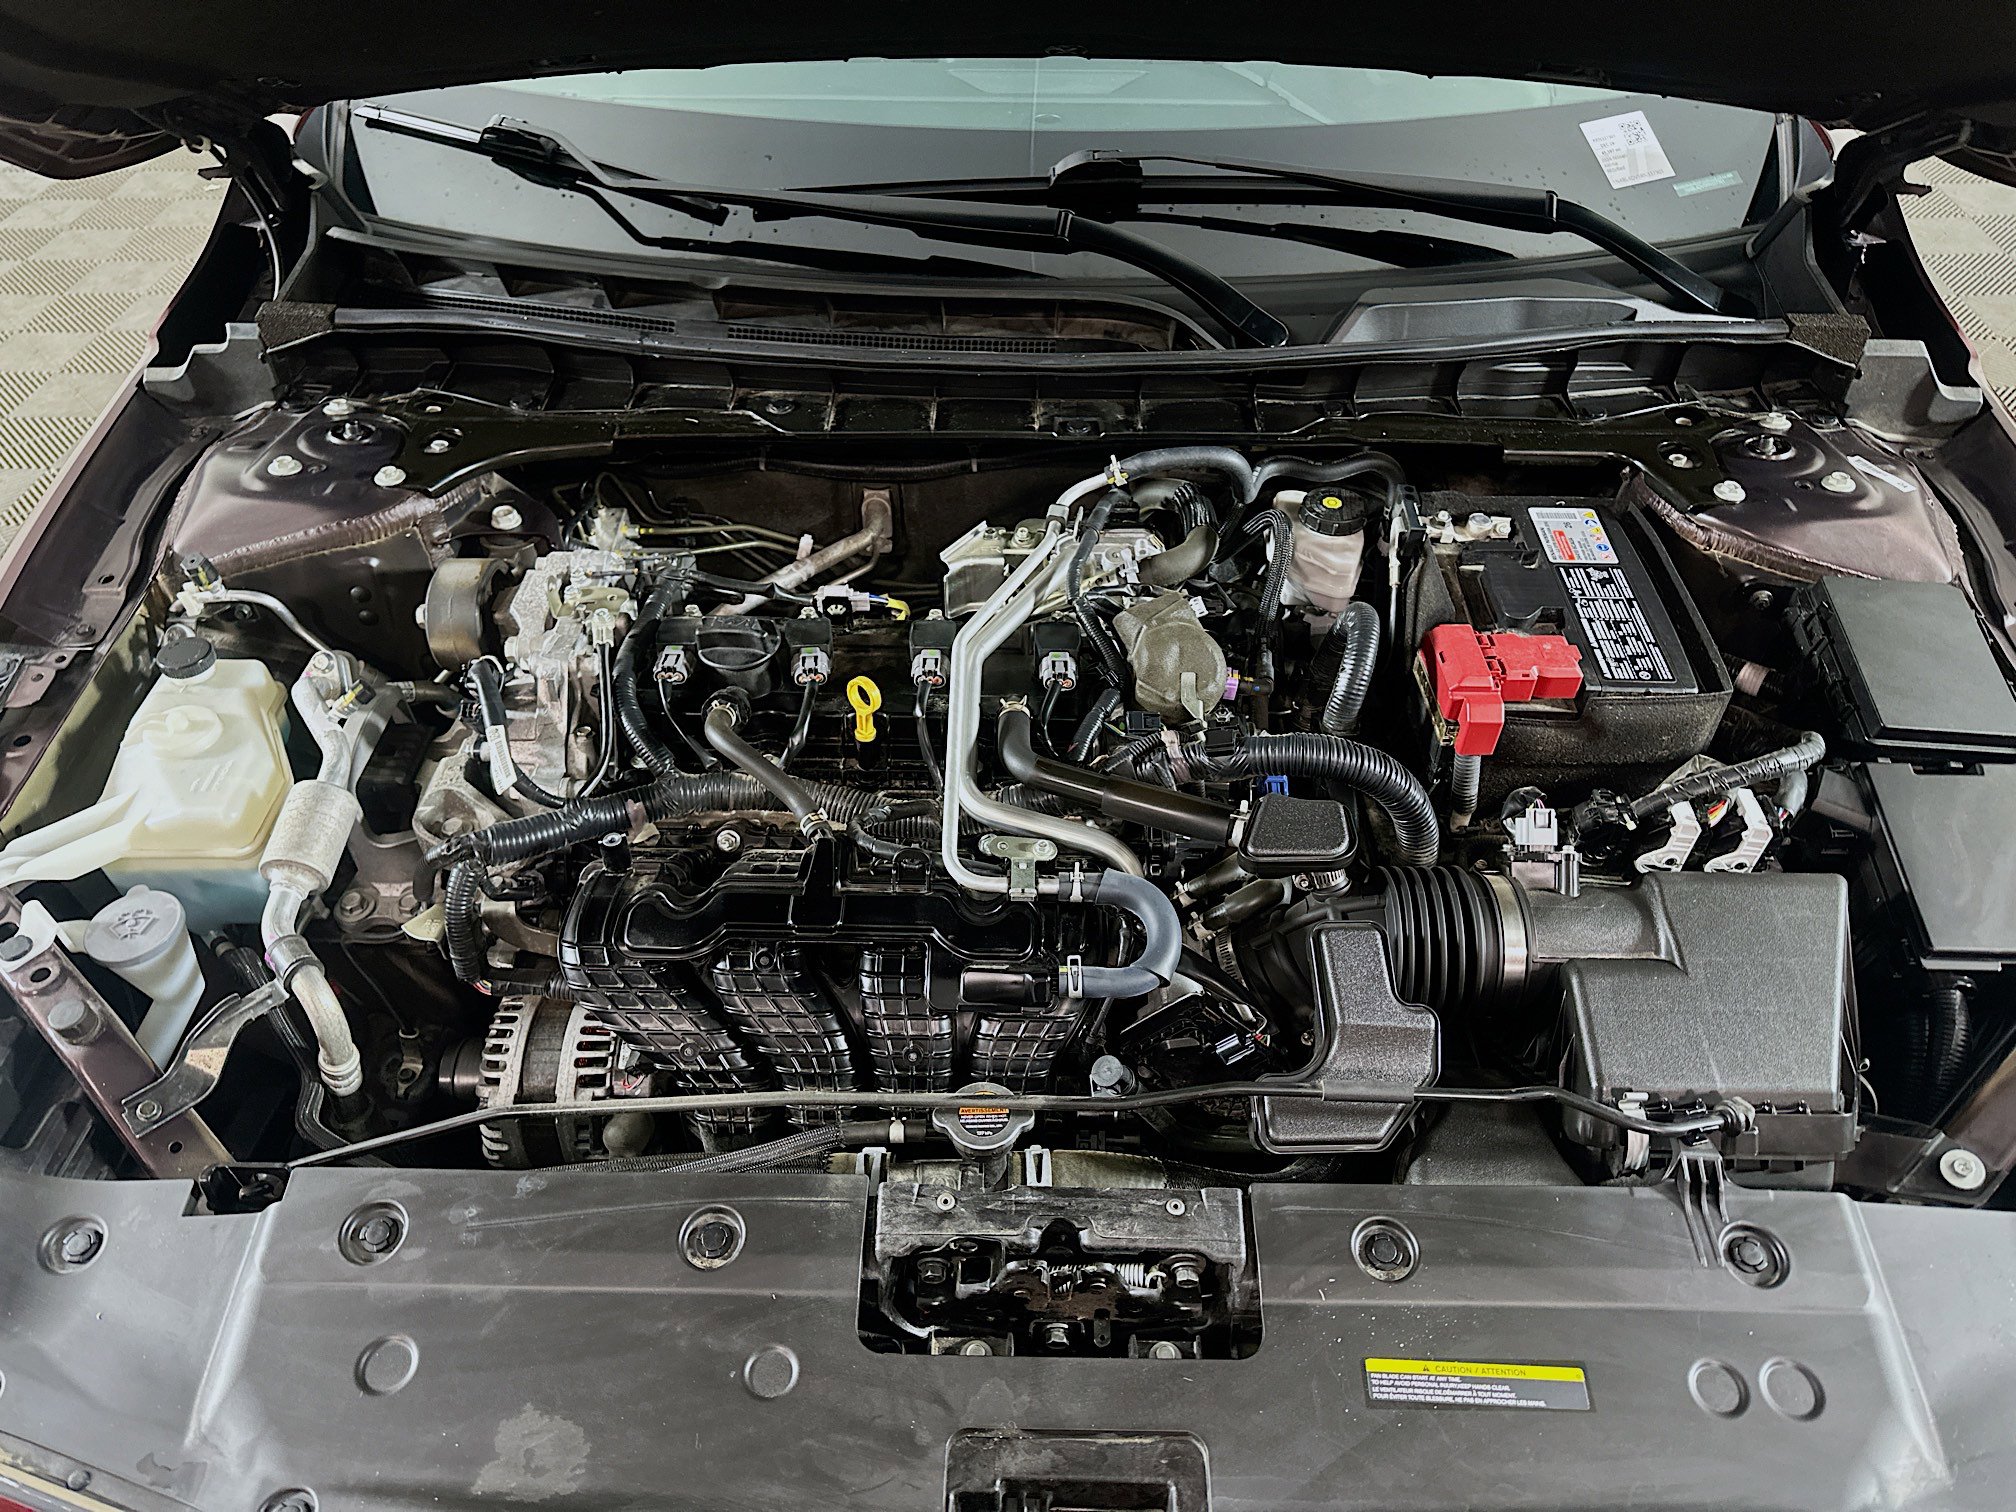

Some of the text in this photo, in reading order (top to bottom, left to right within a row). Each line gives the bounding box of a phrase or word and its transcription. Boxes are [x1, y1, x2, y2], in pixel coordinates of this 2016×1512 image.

[1435, 1365, 1472, 1374] CAUTION
[1481, 1368, 1527, 1376] ATTENTION
[1389, 1392, 1407, 1400] ÉVITER
